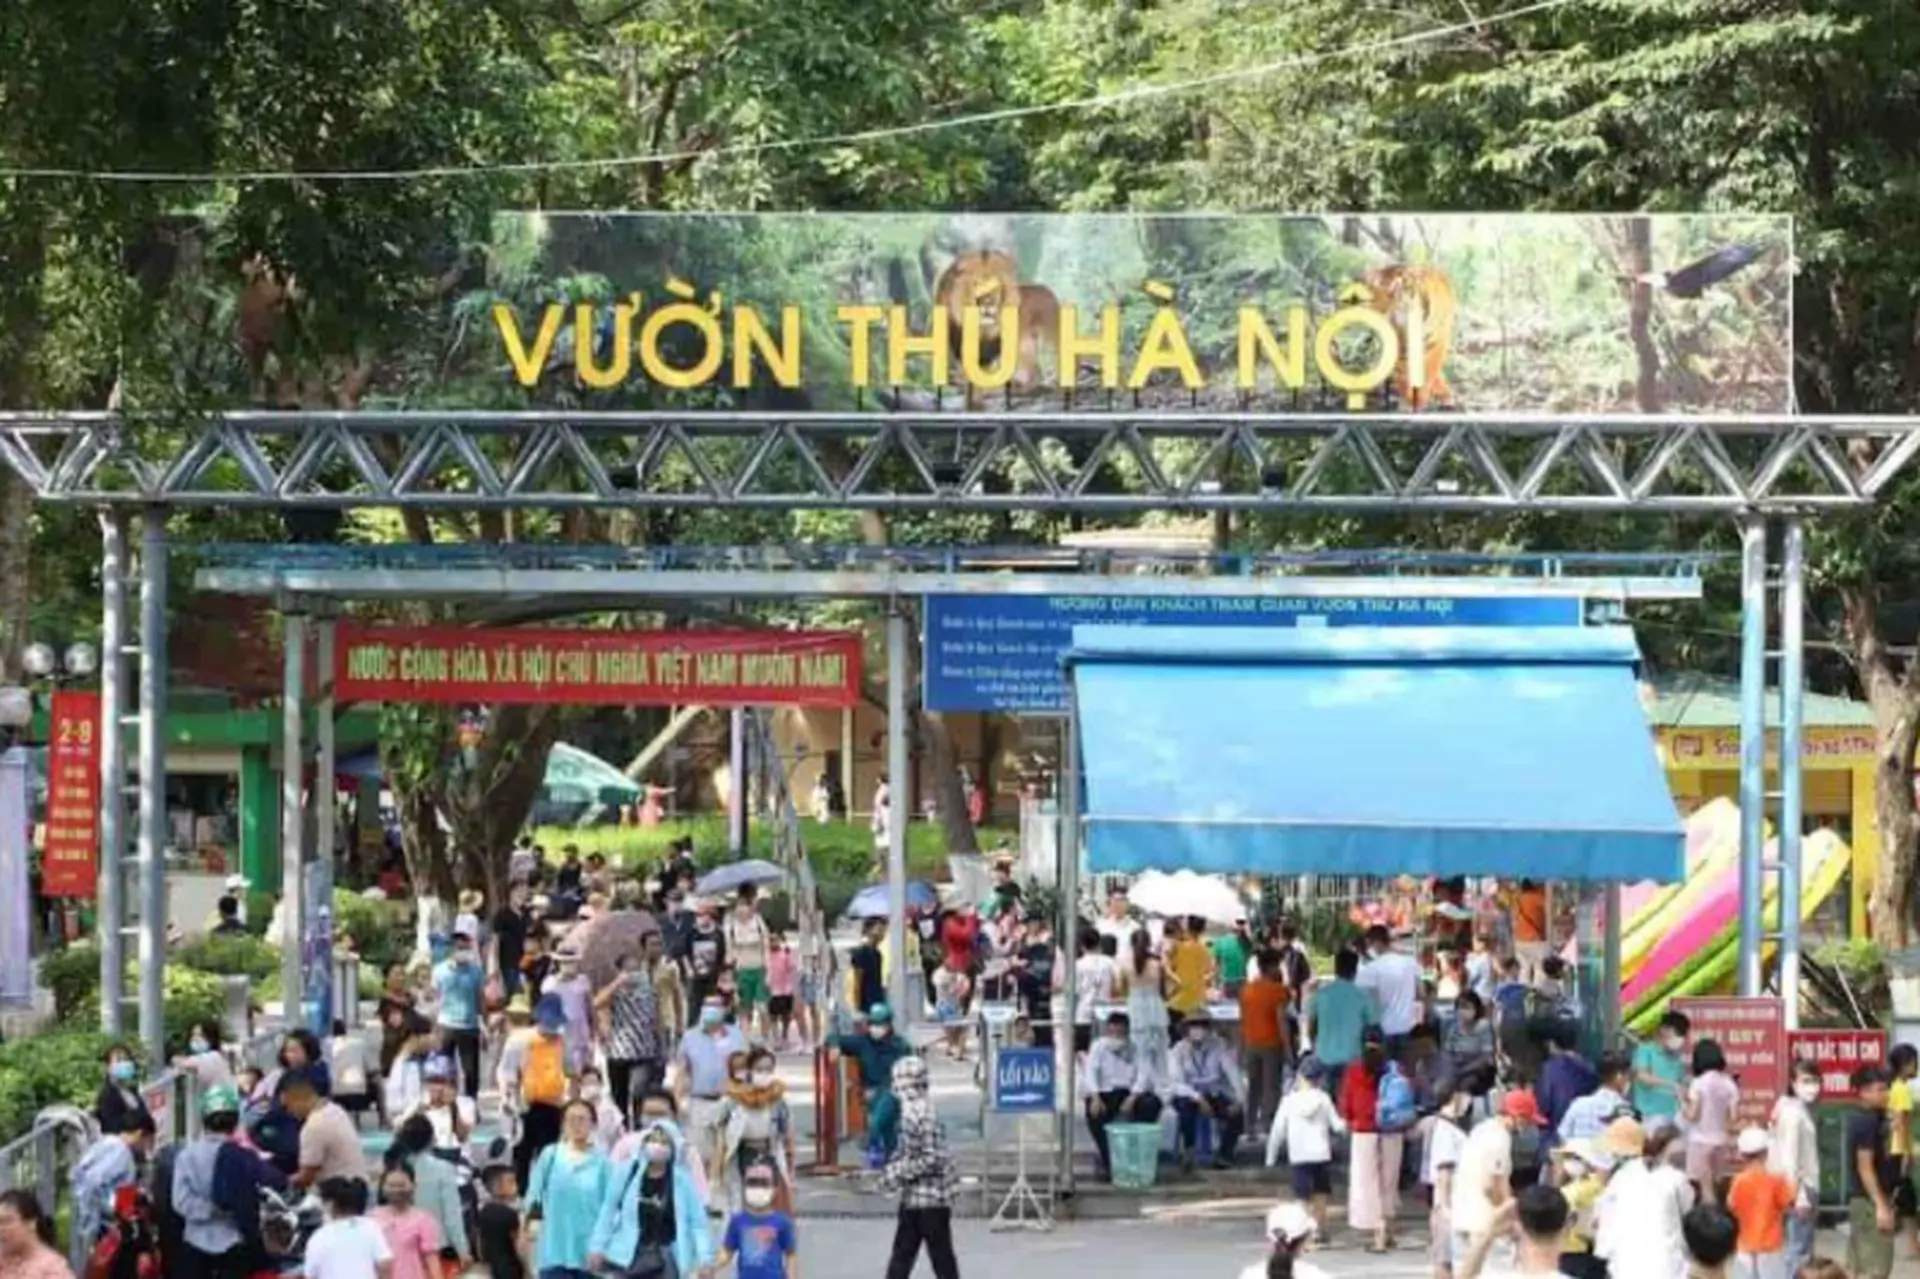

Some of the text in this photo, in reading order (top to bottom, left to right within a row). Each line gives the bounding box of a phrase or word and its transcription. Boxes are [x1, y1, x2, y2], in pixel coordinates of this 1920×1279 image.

[492, 276, 1427, 410] VƯỜN THÚ HÀ NỘI
[400, 641, 448, 690] CỘNG
[493, 643, 517, 683] XÃ
[522, 644, 551, 692] HỘI
[654, 645, 691, 693] VIỆT
[696, 652, 737, 687] NAM
[57, 717, 92, 744] 2-9
